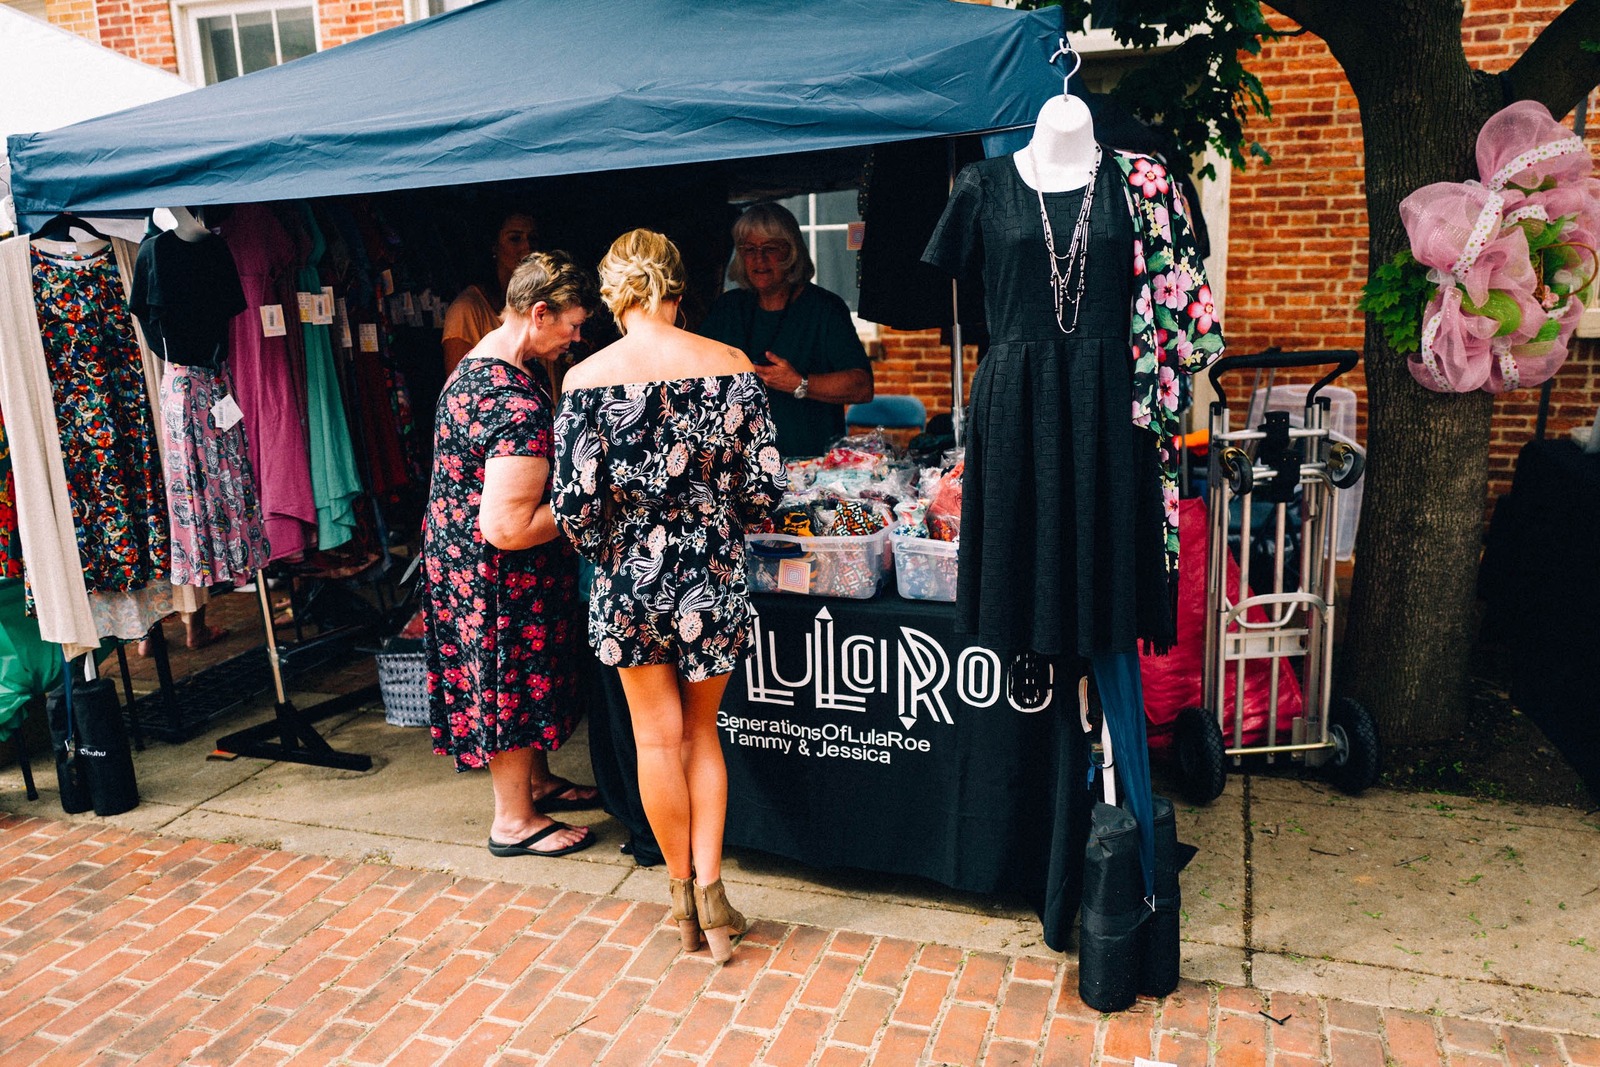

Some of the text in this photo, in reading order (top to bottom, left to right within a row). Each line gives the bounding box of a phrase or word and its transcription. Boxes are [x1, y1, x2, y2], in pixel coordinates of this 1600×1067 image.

[716, 711, 931, 752] GenerationsOfLulaRoe
[725, 728, 891, 764] Tammy & Jessica
